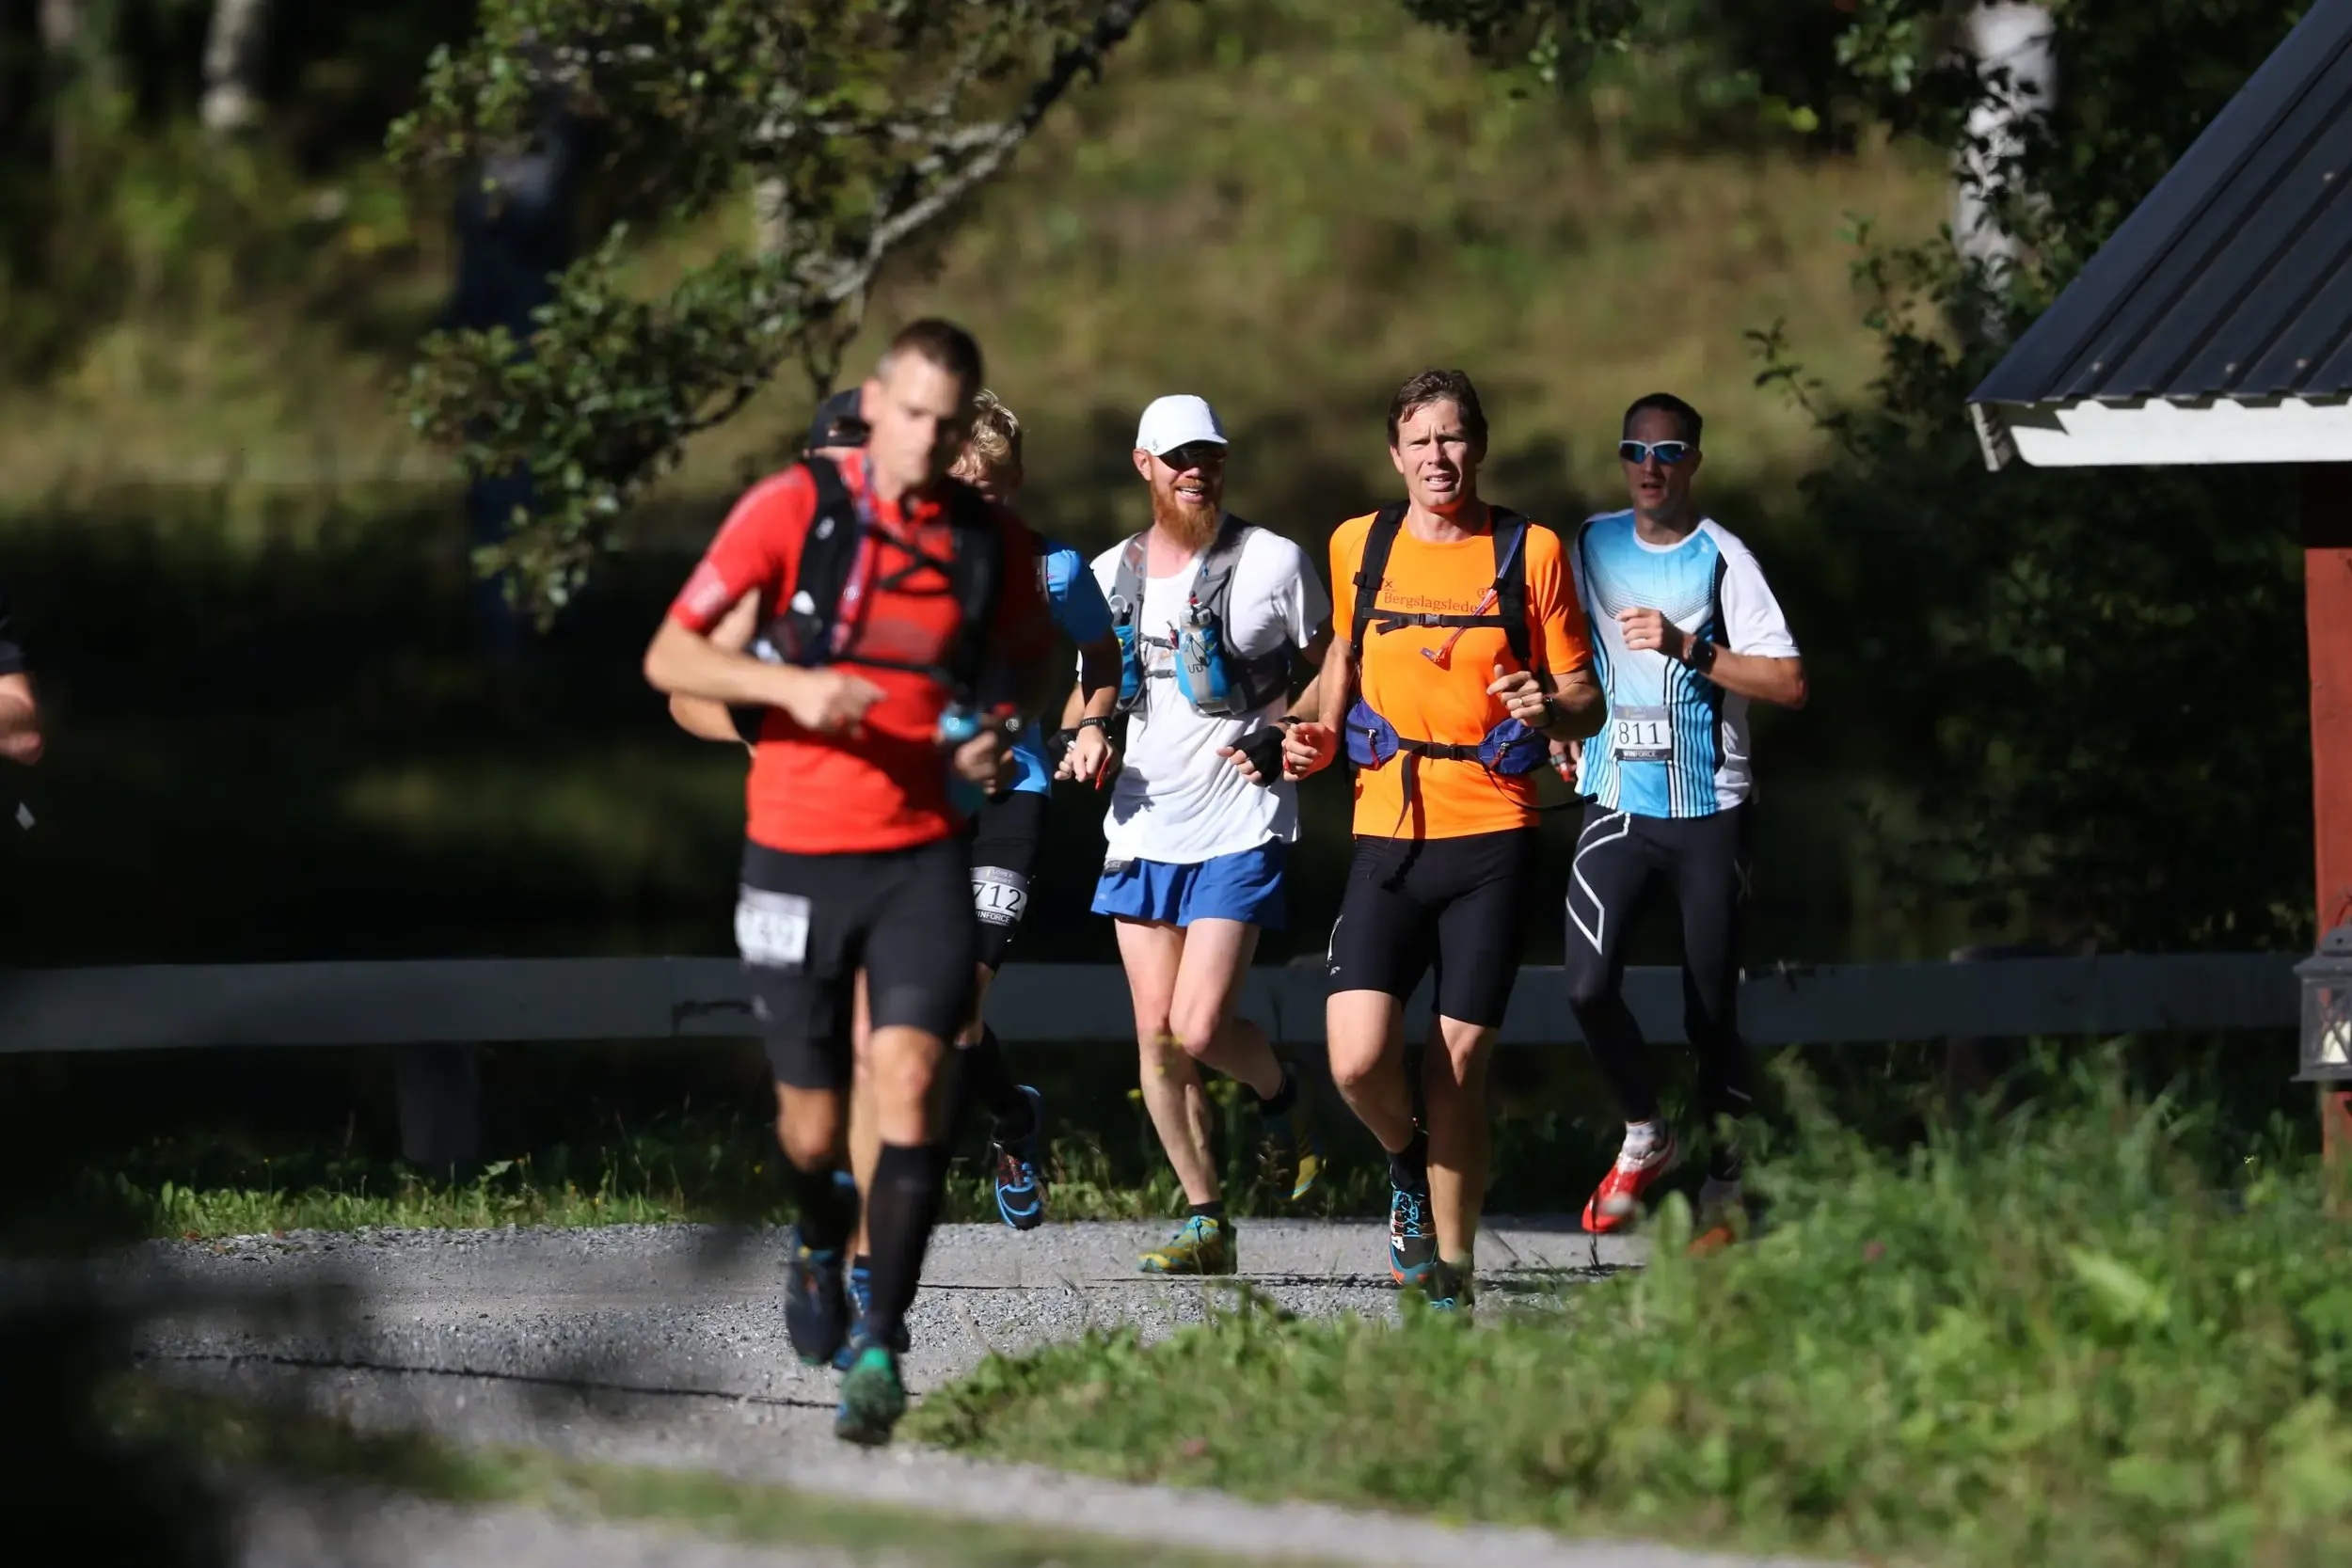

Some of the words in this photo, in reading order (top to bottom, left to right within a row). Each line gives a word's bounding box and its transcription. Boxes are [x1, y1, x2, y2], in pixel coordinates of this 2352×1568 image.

[1384, 592, 1486, 613] Bergslagslede
[1618, 721, 1663, 745] 811
[972, 881, 1021, 913] 712
